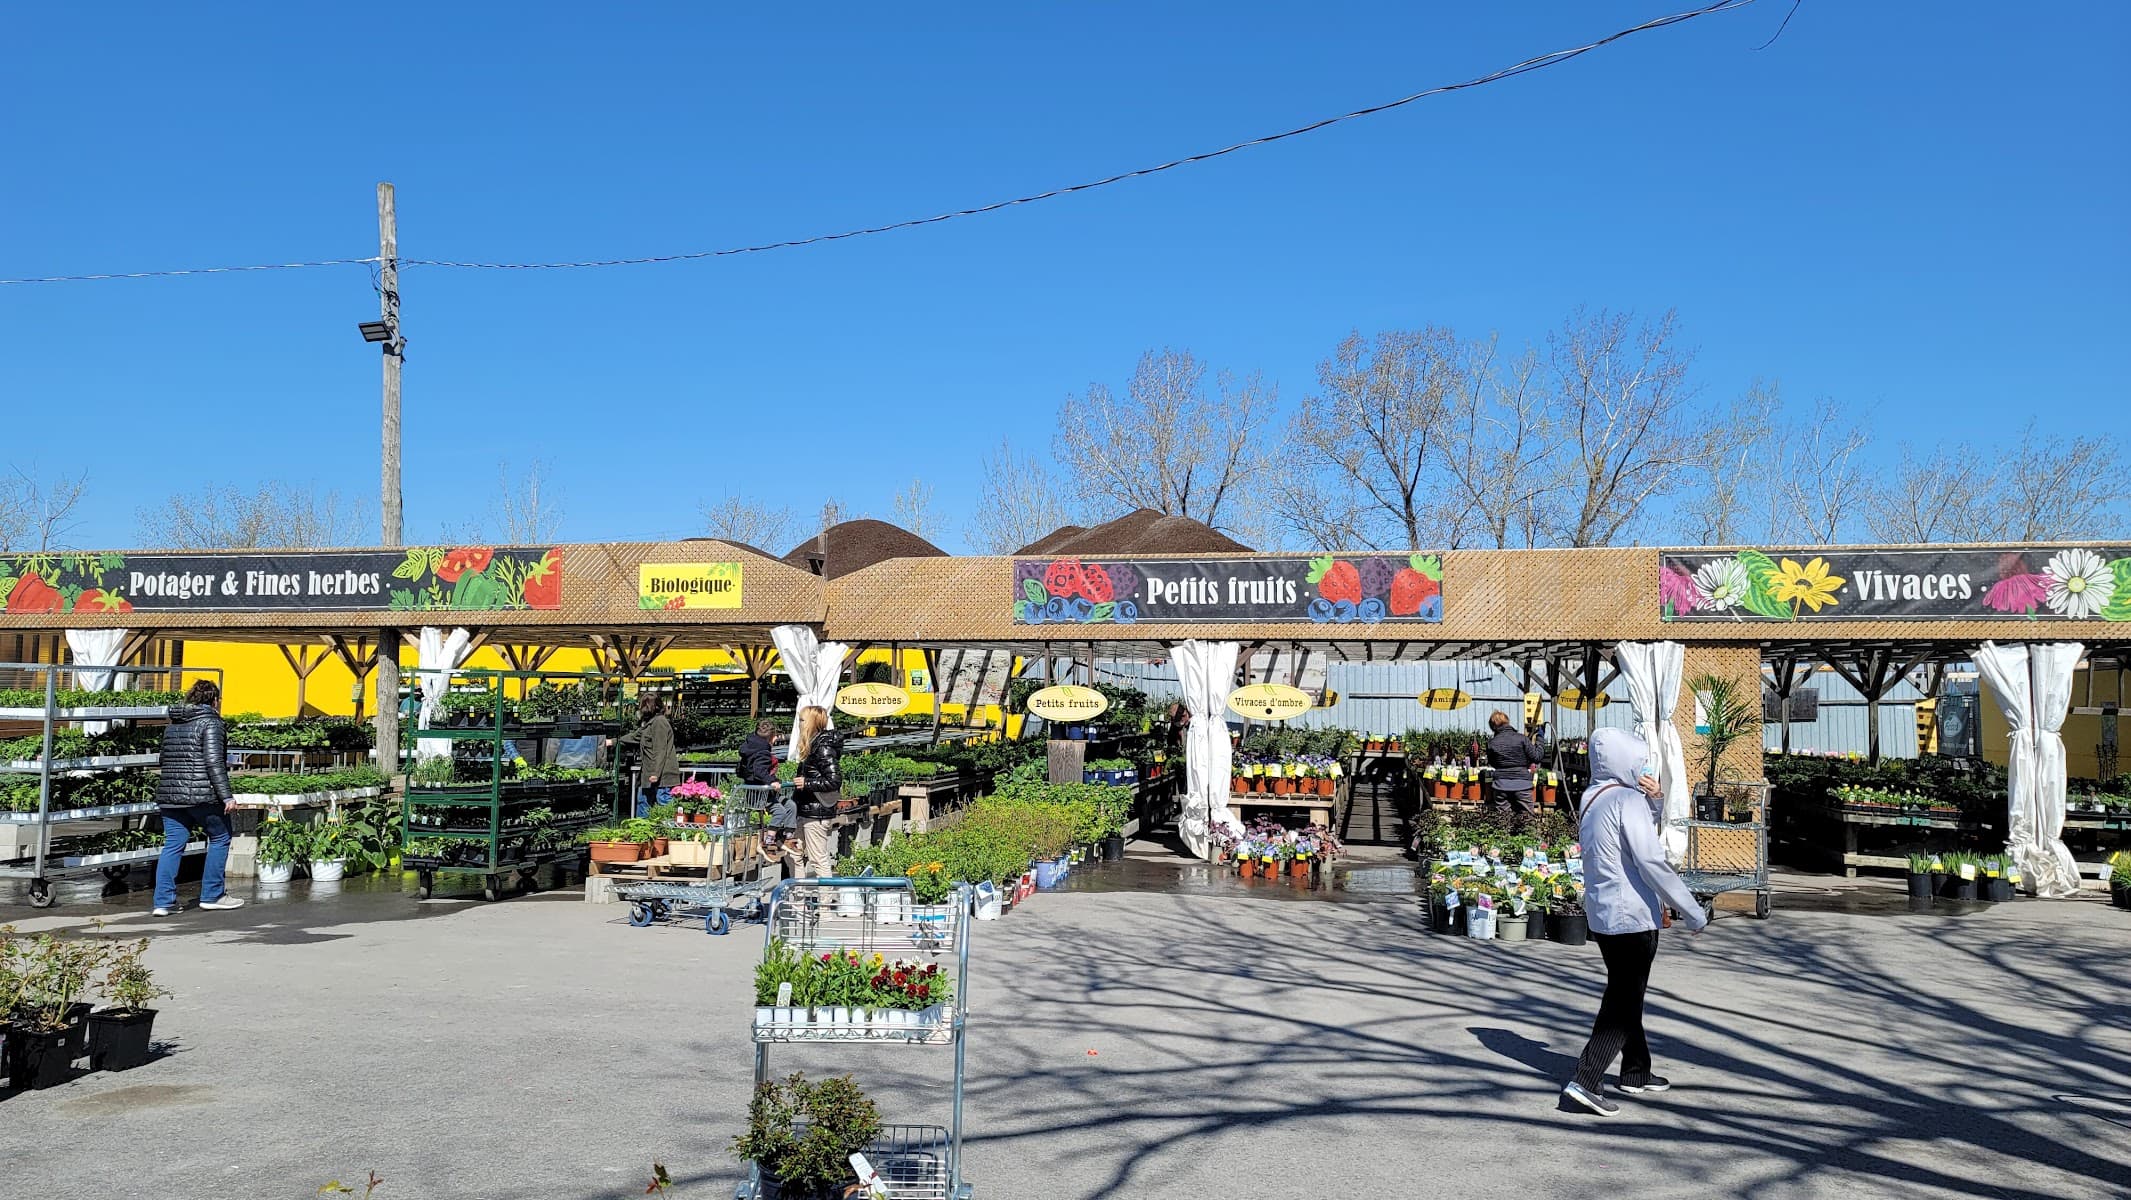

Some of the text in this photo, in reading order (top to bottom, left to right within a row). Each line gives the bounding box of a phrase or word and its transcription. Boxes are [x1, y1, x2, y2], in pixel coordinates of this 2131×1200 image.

[129, 569, 380, 600] Potager & Fines herbes
[650, 577, 732, 595] Biologique
[1146, 576, 1297, 605] Petits fruits
[1852, 569, 1972, 601] Vivaces
[840, 695, 902, 705] Fines herbes
[1035, 698, 1099, 708] Petits fruits
[1235, 697, 1303, 707] Vivaces d'ombre
